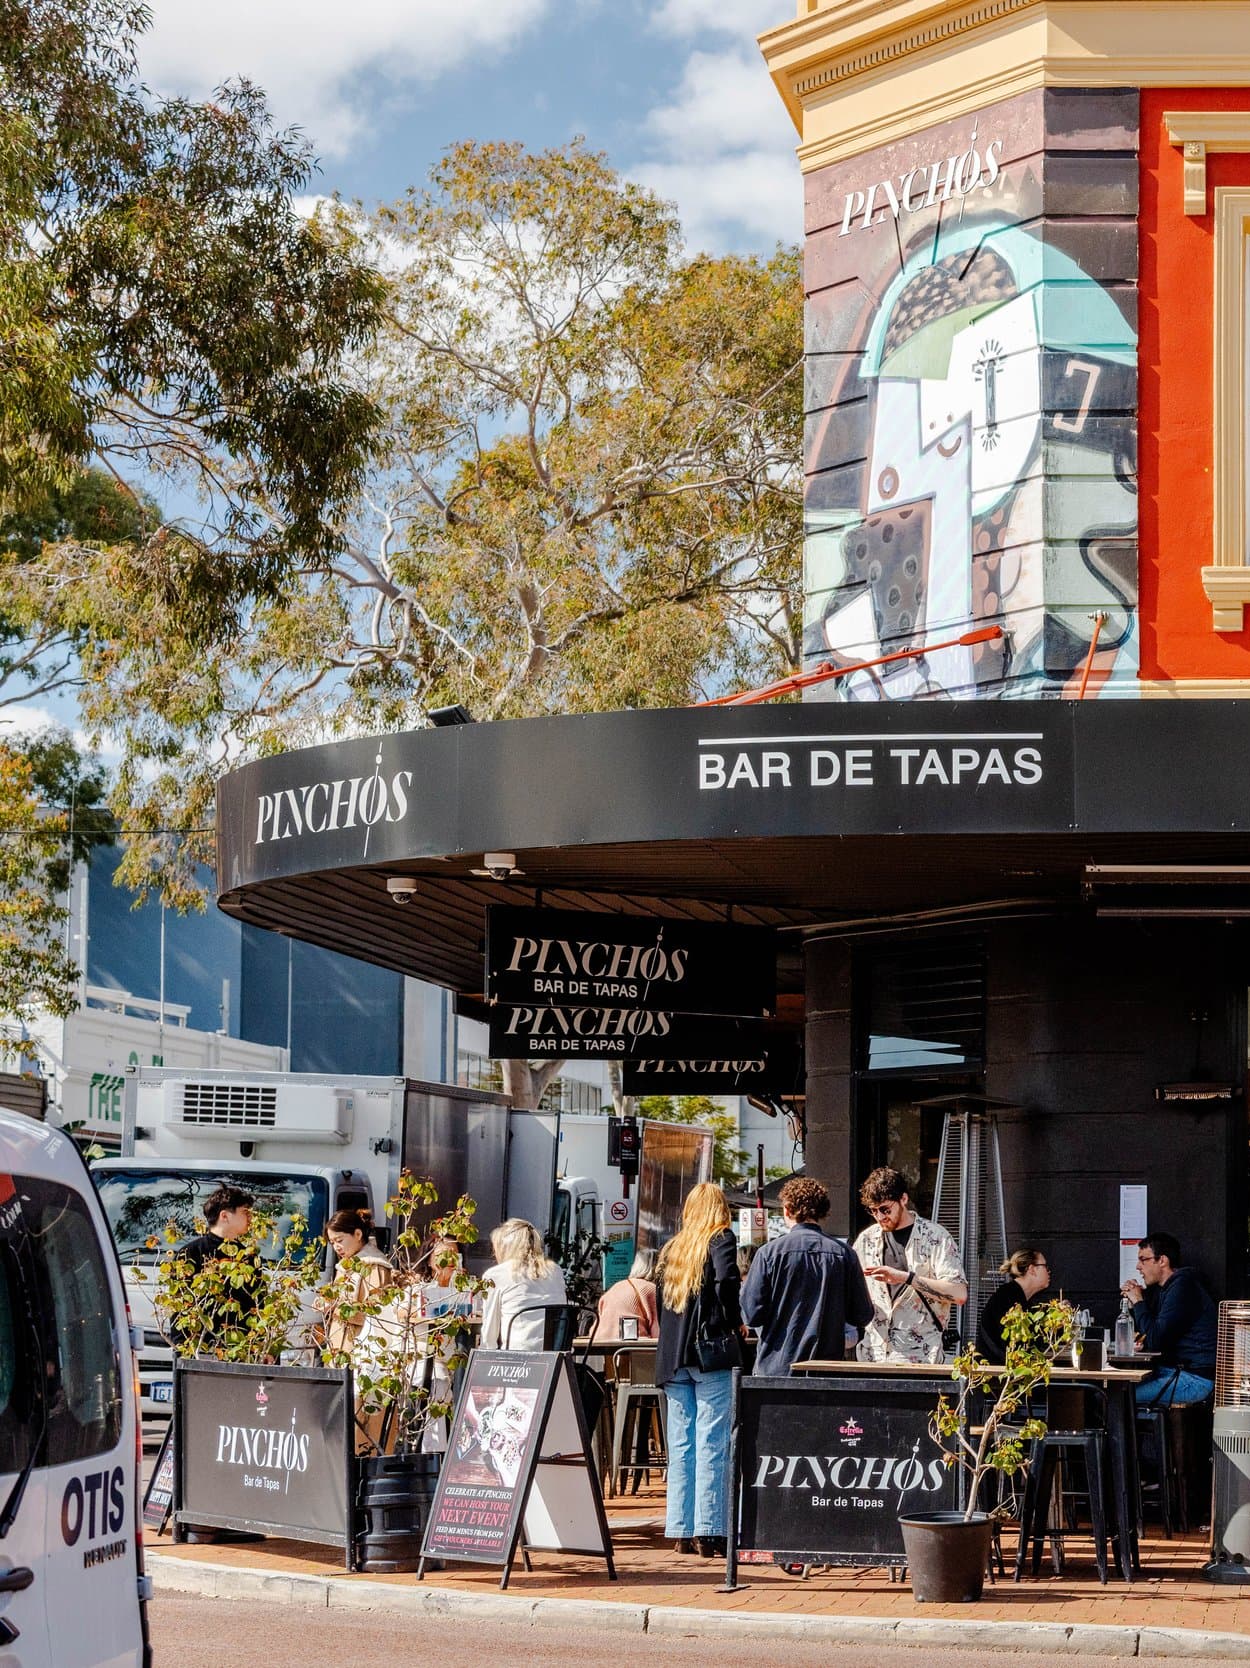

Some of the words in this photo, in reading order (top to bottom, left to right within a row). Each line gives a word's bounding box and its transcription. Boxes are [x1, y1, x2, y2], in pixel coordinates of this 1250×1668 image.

[699, 751, 792, 790] BAR
[810, 749, 874, 787] DE
[890, 747, 1043, 786] TAPAS
[534, 978, 564, 994] BAR
[568, 981, 589, 995] DE
[593, 982, 638, 998] TAPAS
[529, 1039, 557, 1051] BAR
[561, 1039, 580, 1051] DE
[583, 1039, 626, 1051] TAPAS
[244, 1474, 254, 1487] Bar
[254, 1476, 263, 1488] de
[262, 1476, 280, 1492] Tapas
[445, 1487, 476, 1497] CELEBRATE
[476, 1489, 486, 1498] AT
[61, 1466, 125, 1547] OTIS
[443, 1498, 454, 1507] WE
[453, 1499, 470, 1508] CAN
[469, 1500, 490, 1509] HOST
[490, 1501, 510, 1512] YOUR
[811, 1496, 830, 1507] Bar
[834, 1496, 848, 1507] de
[850, 1497, 884, 1509] Tapas
[438, 1508, 469, 1523] NEXT
[469, 1510, 509, 1528] EVENT
[473, 1529, 488, 1537] FROM
